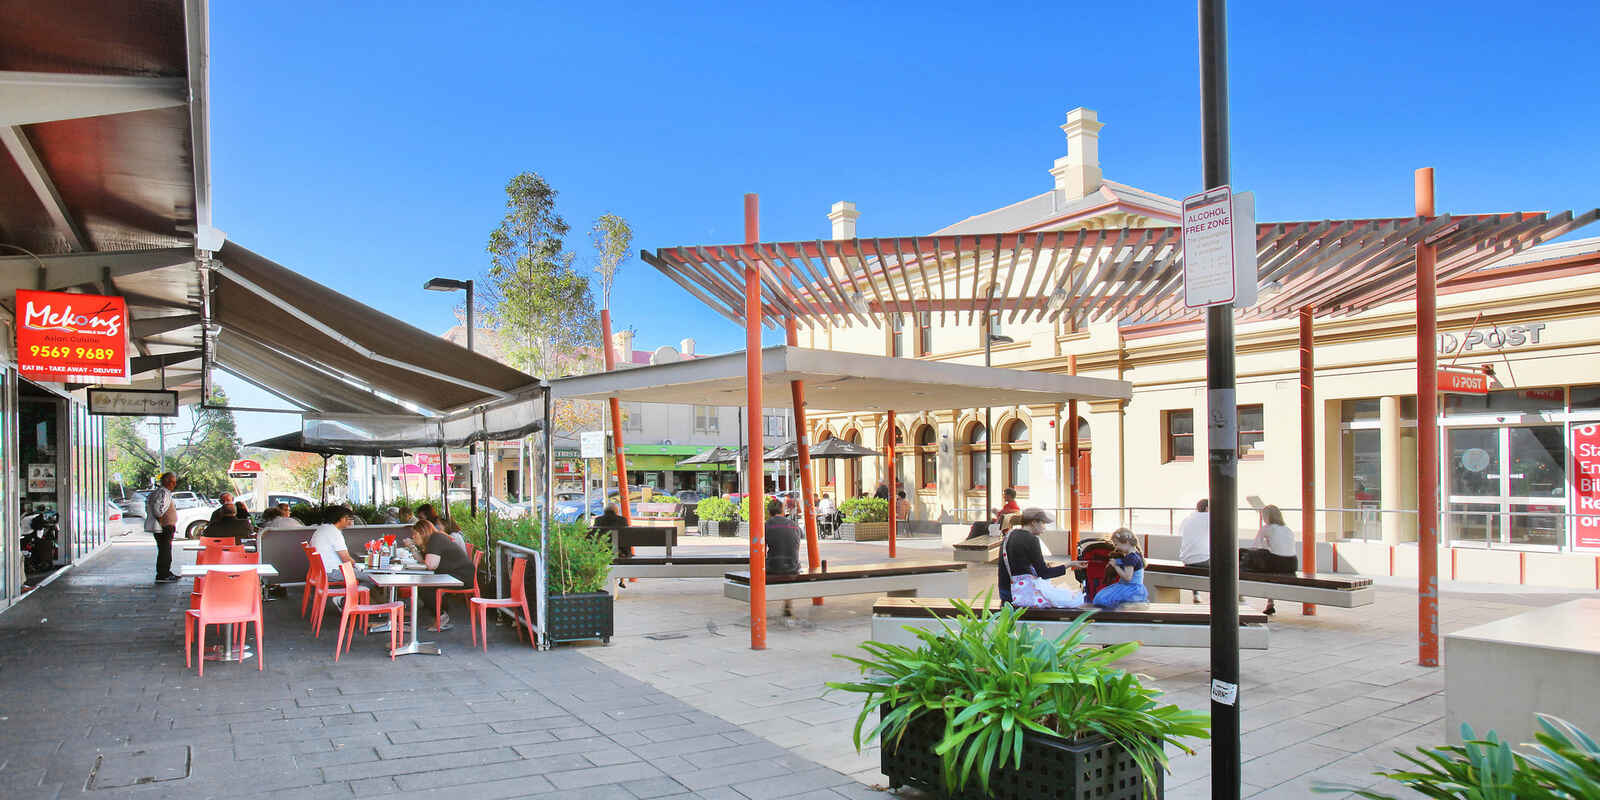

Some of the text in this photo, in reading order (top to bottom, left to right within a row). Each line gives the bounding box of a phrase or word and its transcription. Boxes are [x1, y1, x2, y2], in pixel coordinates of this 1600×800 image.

[1188, 207, 1226, 223] ALCOHOL
[1186, 217, 1229, 234] FREE ZONE
[24, 300, 120, 336] Mekong
[45, 335, 67, 343] Asian
[1464, 323, 1546, 350] POST
[30, 345, 114, 360] 9569 9689
[1460, 376, 1483, 389] POST
